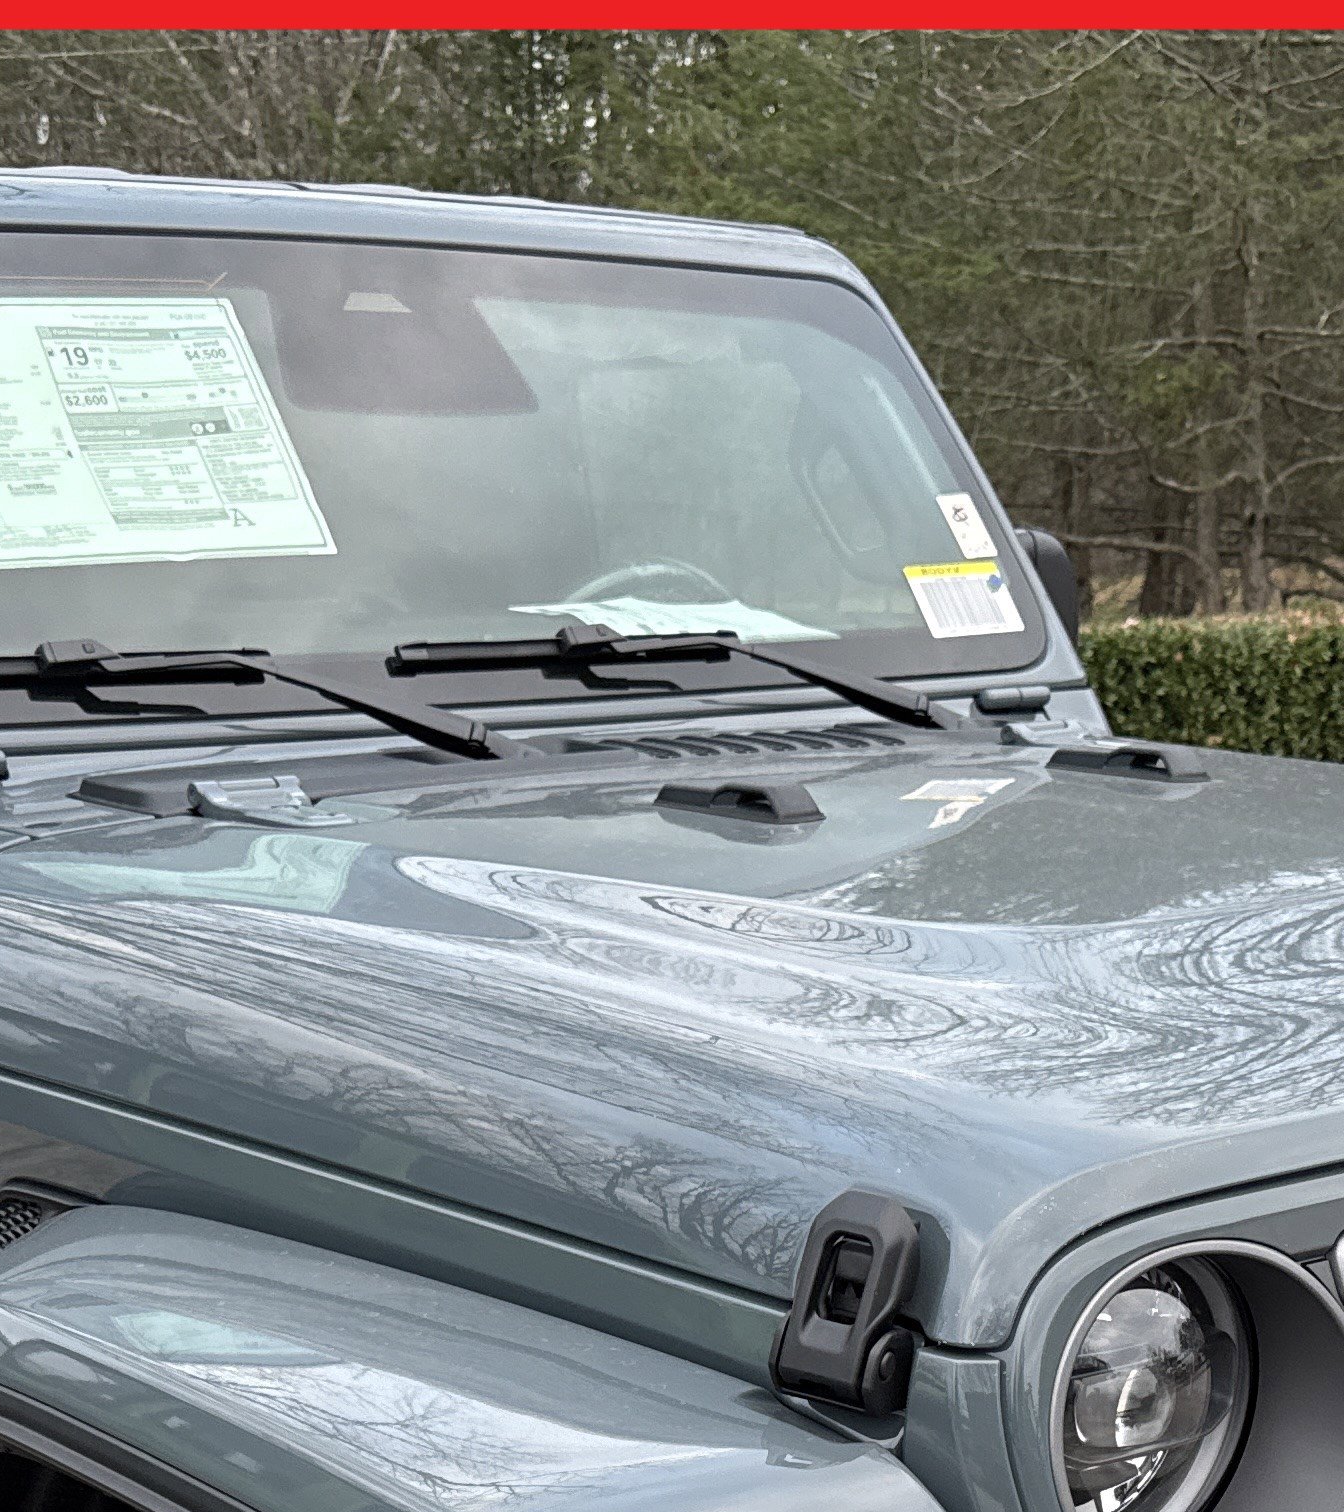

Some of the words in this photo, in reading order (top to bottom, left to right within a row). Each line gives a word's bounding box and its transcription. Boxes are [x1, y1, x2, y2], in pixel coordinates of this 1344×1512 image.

[60, 346, 89, 366] 19
[184, 348, 227, 361] $4,500
[64, 394, 108, 407] $2,600
[229, 508, 256, 527] A
